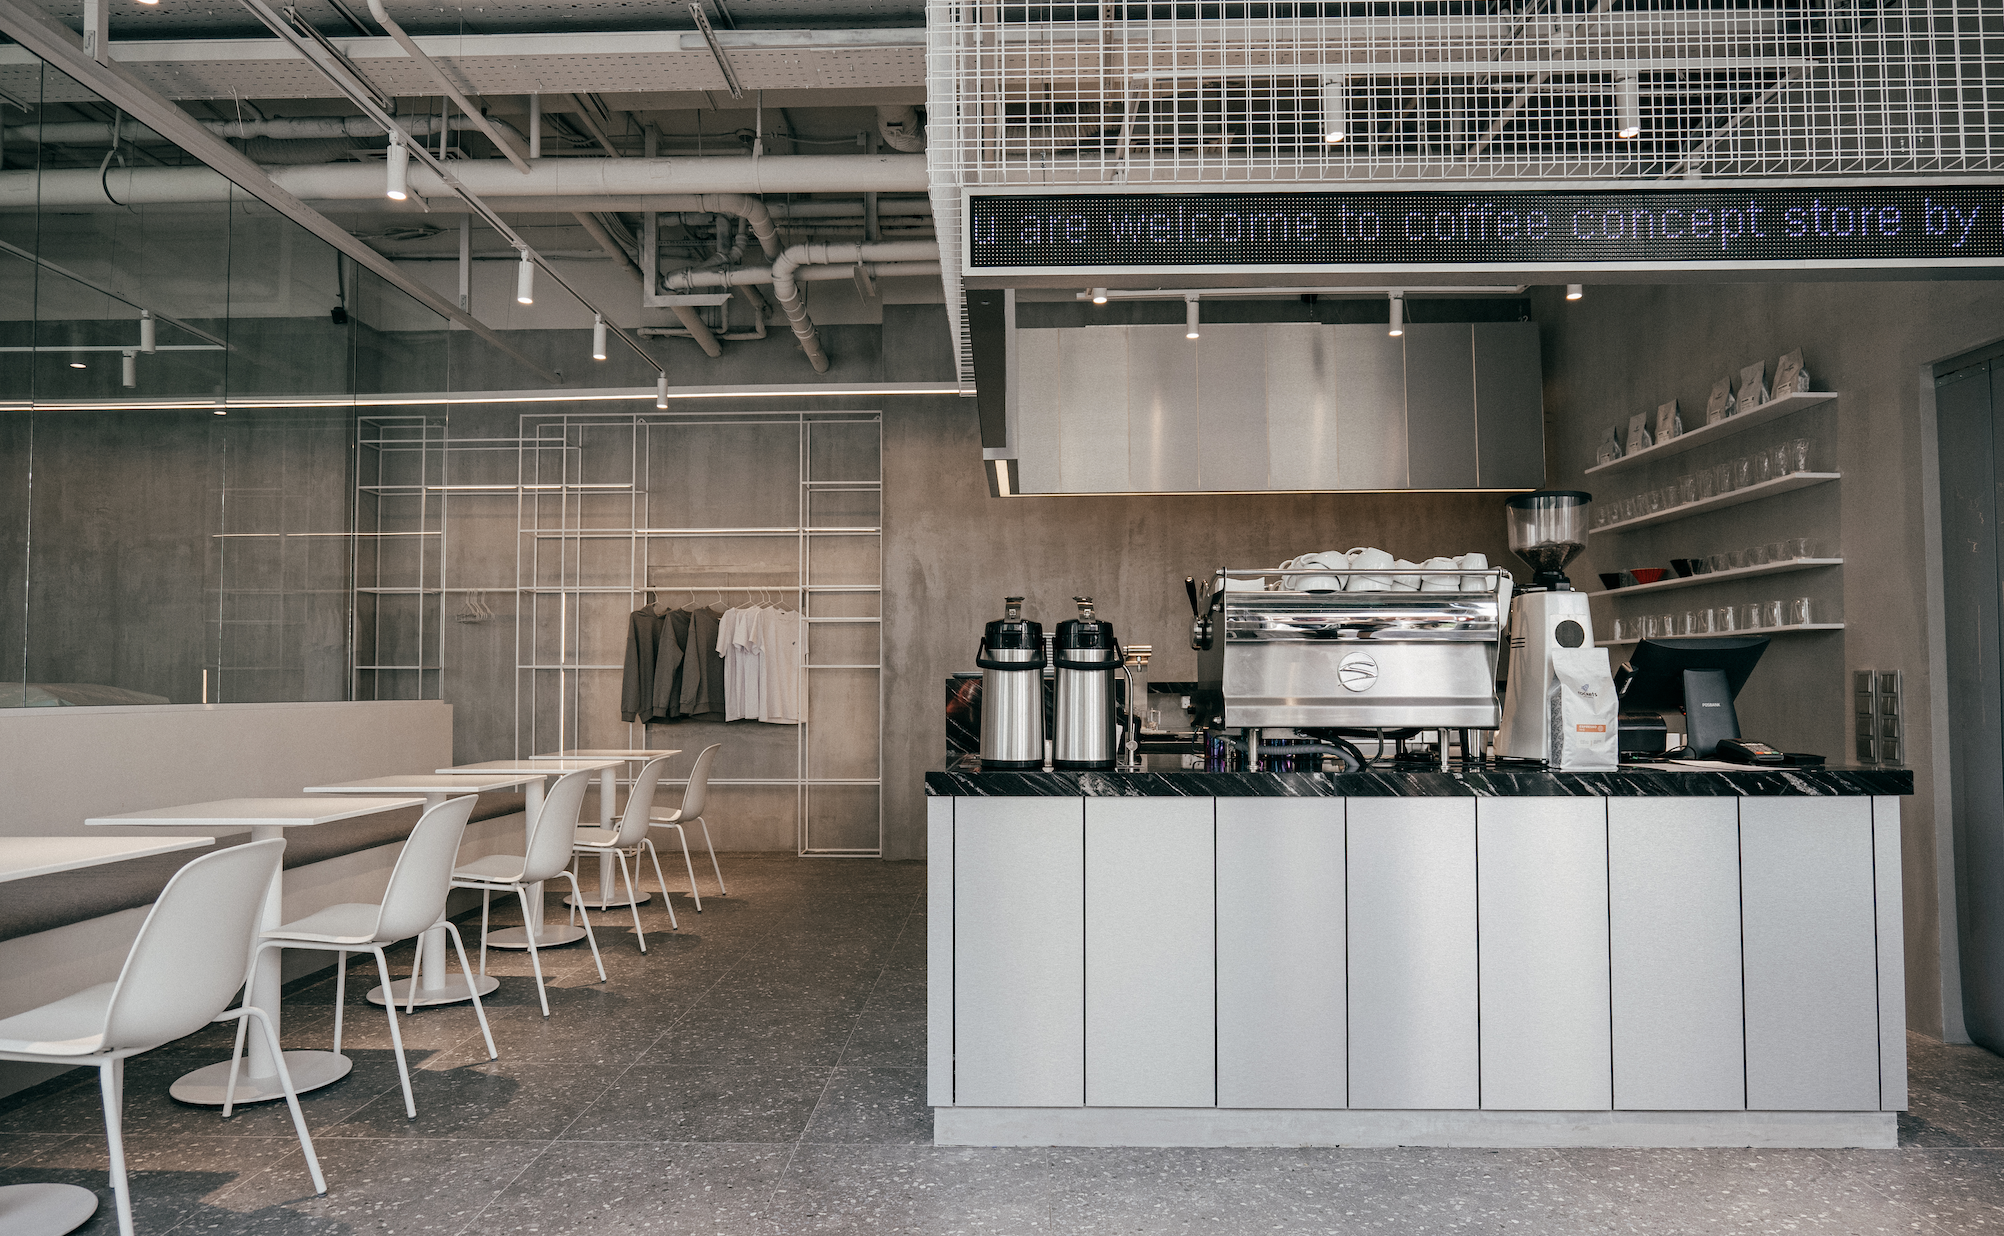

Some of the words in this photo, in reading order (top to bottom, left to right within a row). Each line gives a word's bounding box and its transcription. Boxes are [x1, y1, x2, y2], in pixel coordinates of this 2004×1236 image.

[1019, 214, 1087, 244] are
[1107, 205, 1318, 243] welcome
[1339, 203, 1381, 241] to
[1405, 201, 1549, 240] coffee
[1573, 199, 1765, 251] concept
[1784, 196, 1901, 238] store
[1924, 196, 1982, 248] by
